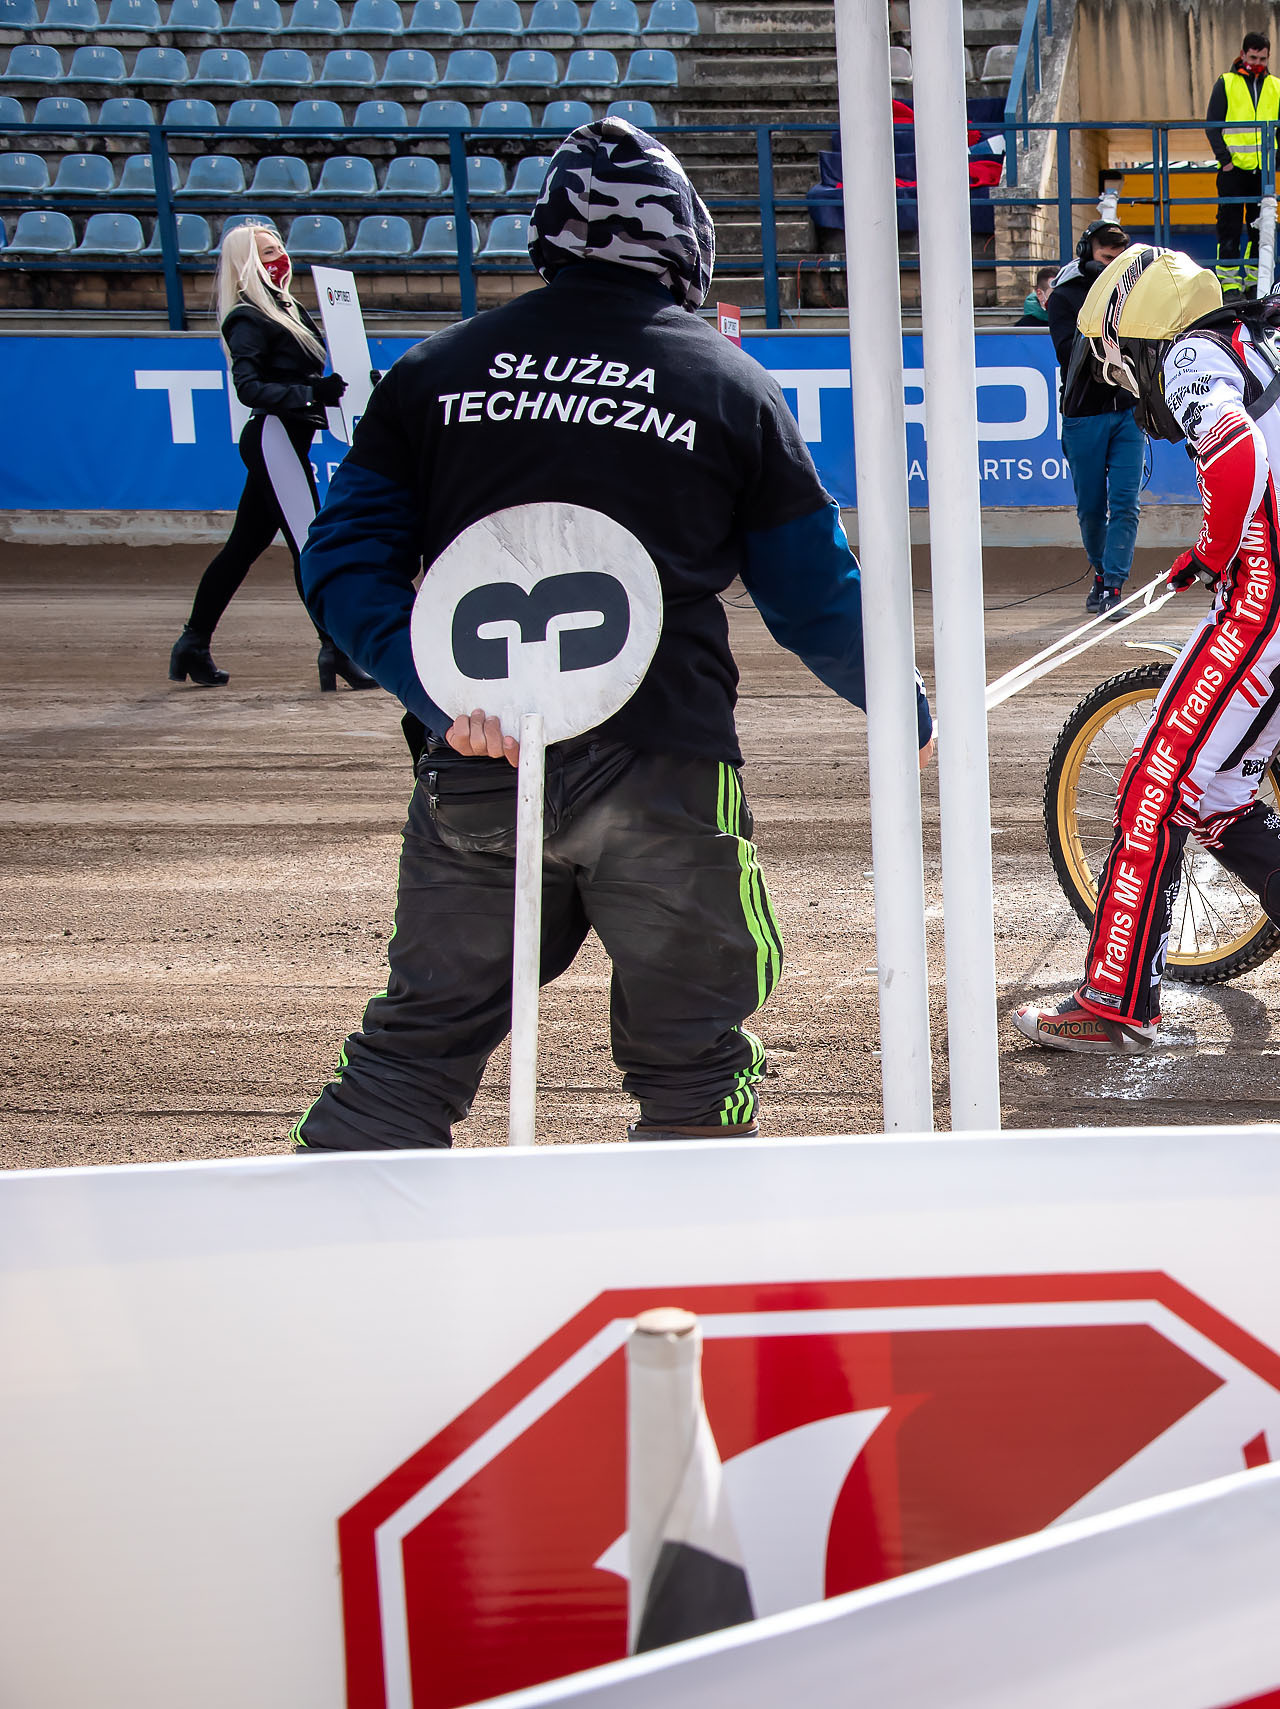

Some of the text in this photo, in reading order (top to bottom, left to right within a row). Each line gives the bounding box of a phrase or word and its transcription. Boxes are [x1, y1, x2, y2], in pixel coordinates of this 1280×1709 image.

[488, 352, 656, 395] SŁUŻBA
[438, 390, 698, 451] TECHNICZNA
[1235, 555, 1270, 622] Trans
[452, 571, 630, 680] 3
[1167, 619, 1246, 736] Trans MF
[1125, 738, 1180, 853] Trans MF
[1112, 861, 1145, 912] MF
[1094, 909, 1134, 983] Trans
